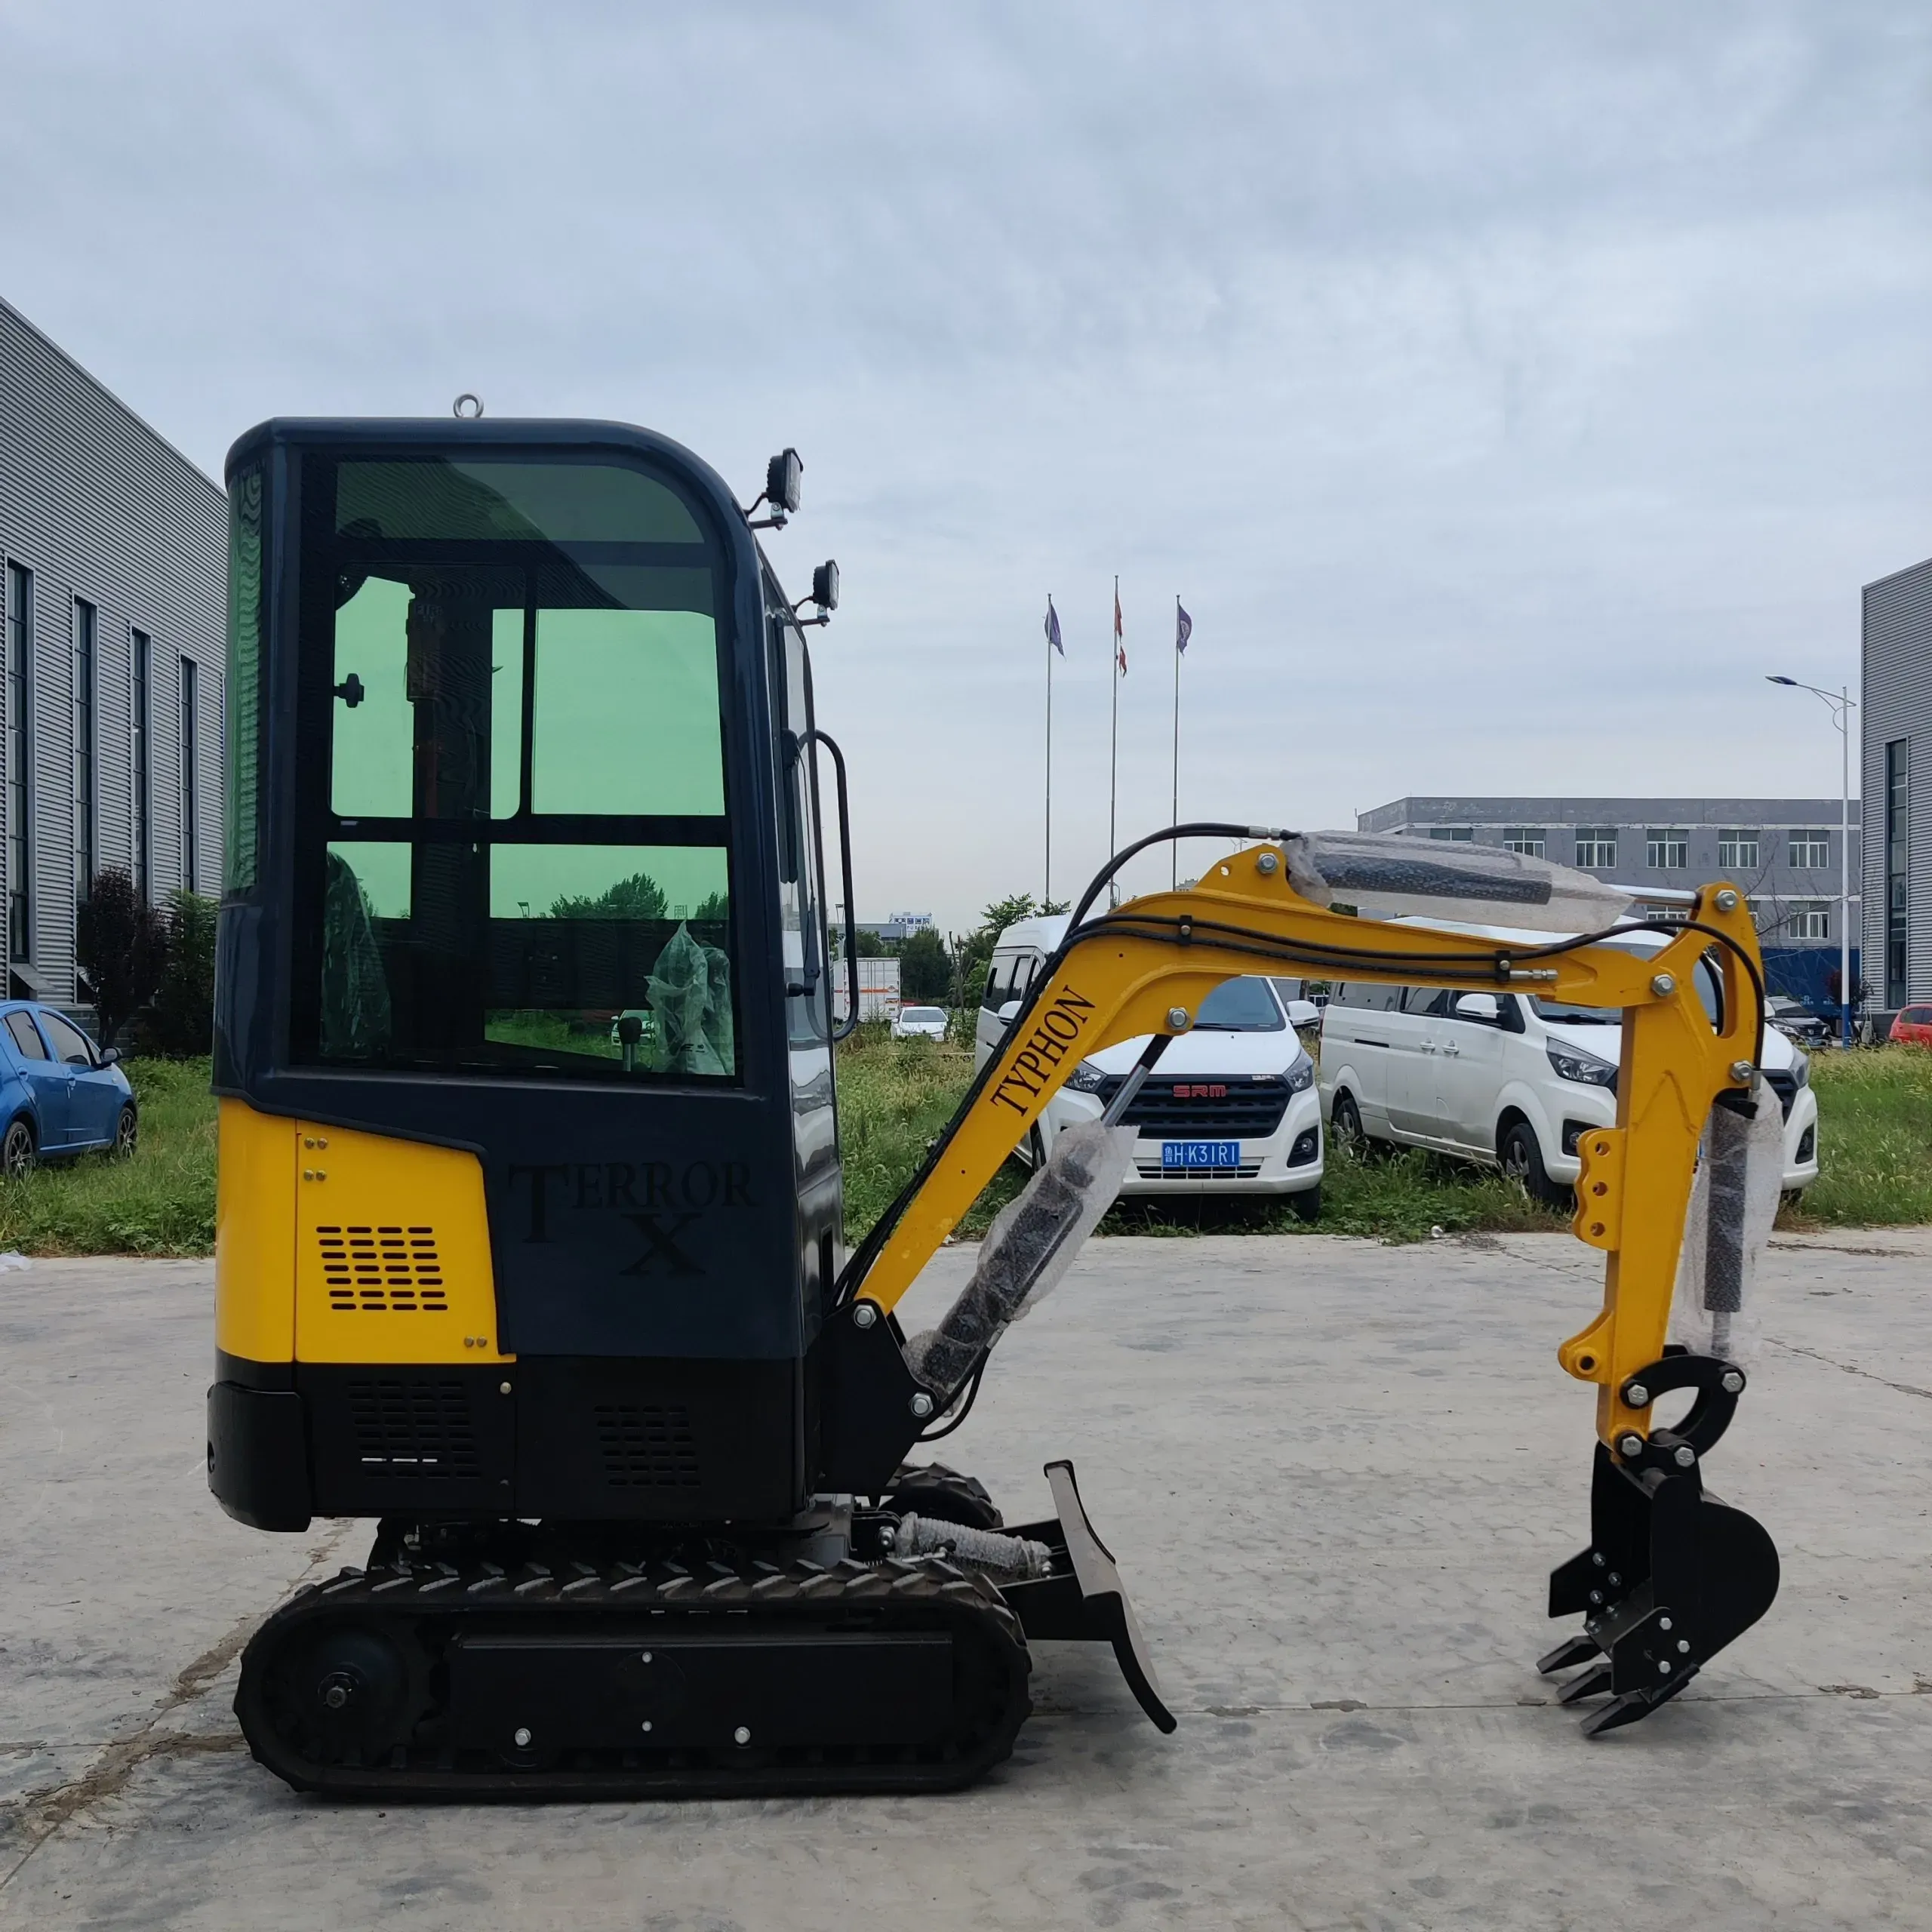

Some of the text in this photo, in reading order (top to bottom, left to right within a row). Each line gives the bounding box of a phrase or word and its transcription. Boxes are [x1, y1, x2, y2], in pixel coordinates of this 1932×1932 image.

[990, 985, 1096, 1117] TYPHON
[1174, 1085, 1226, 1097] SRM
[508, 1160, 759, 1244] TERROR
[618, 1212, 706, 1275] X
